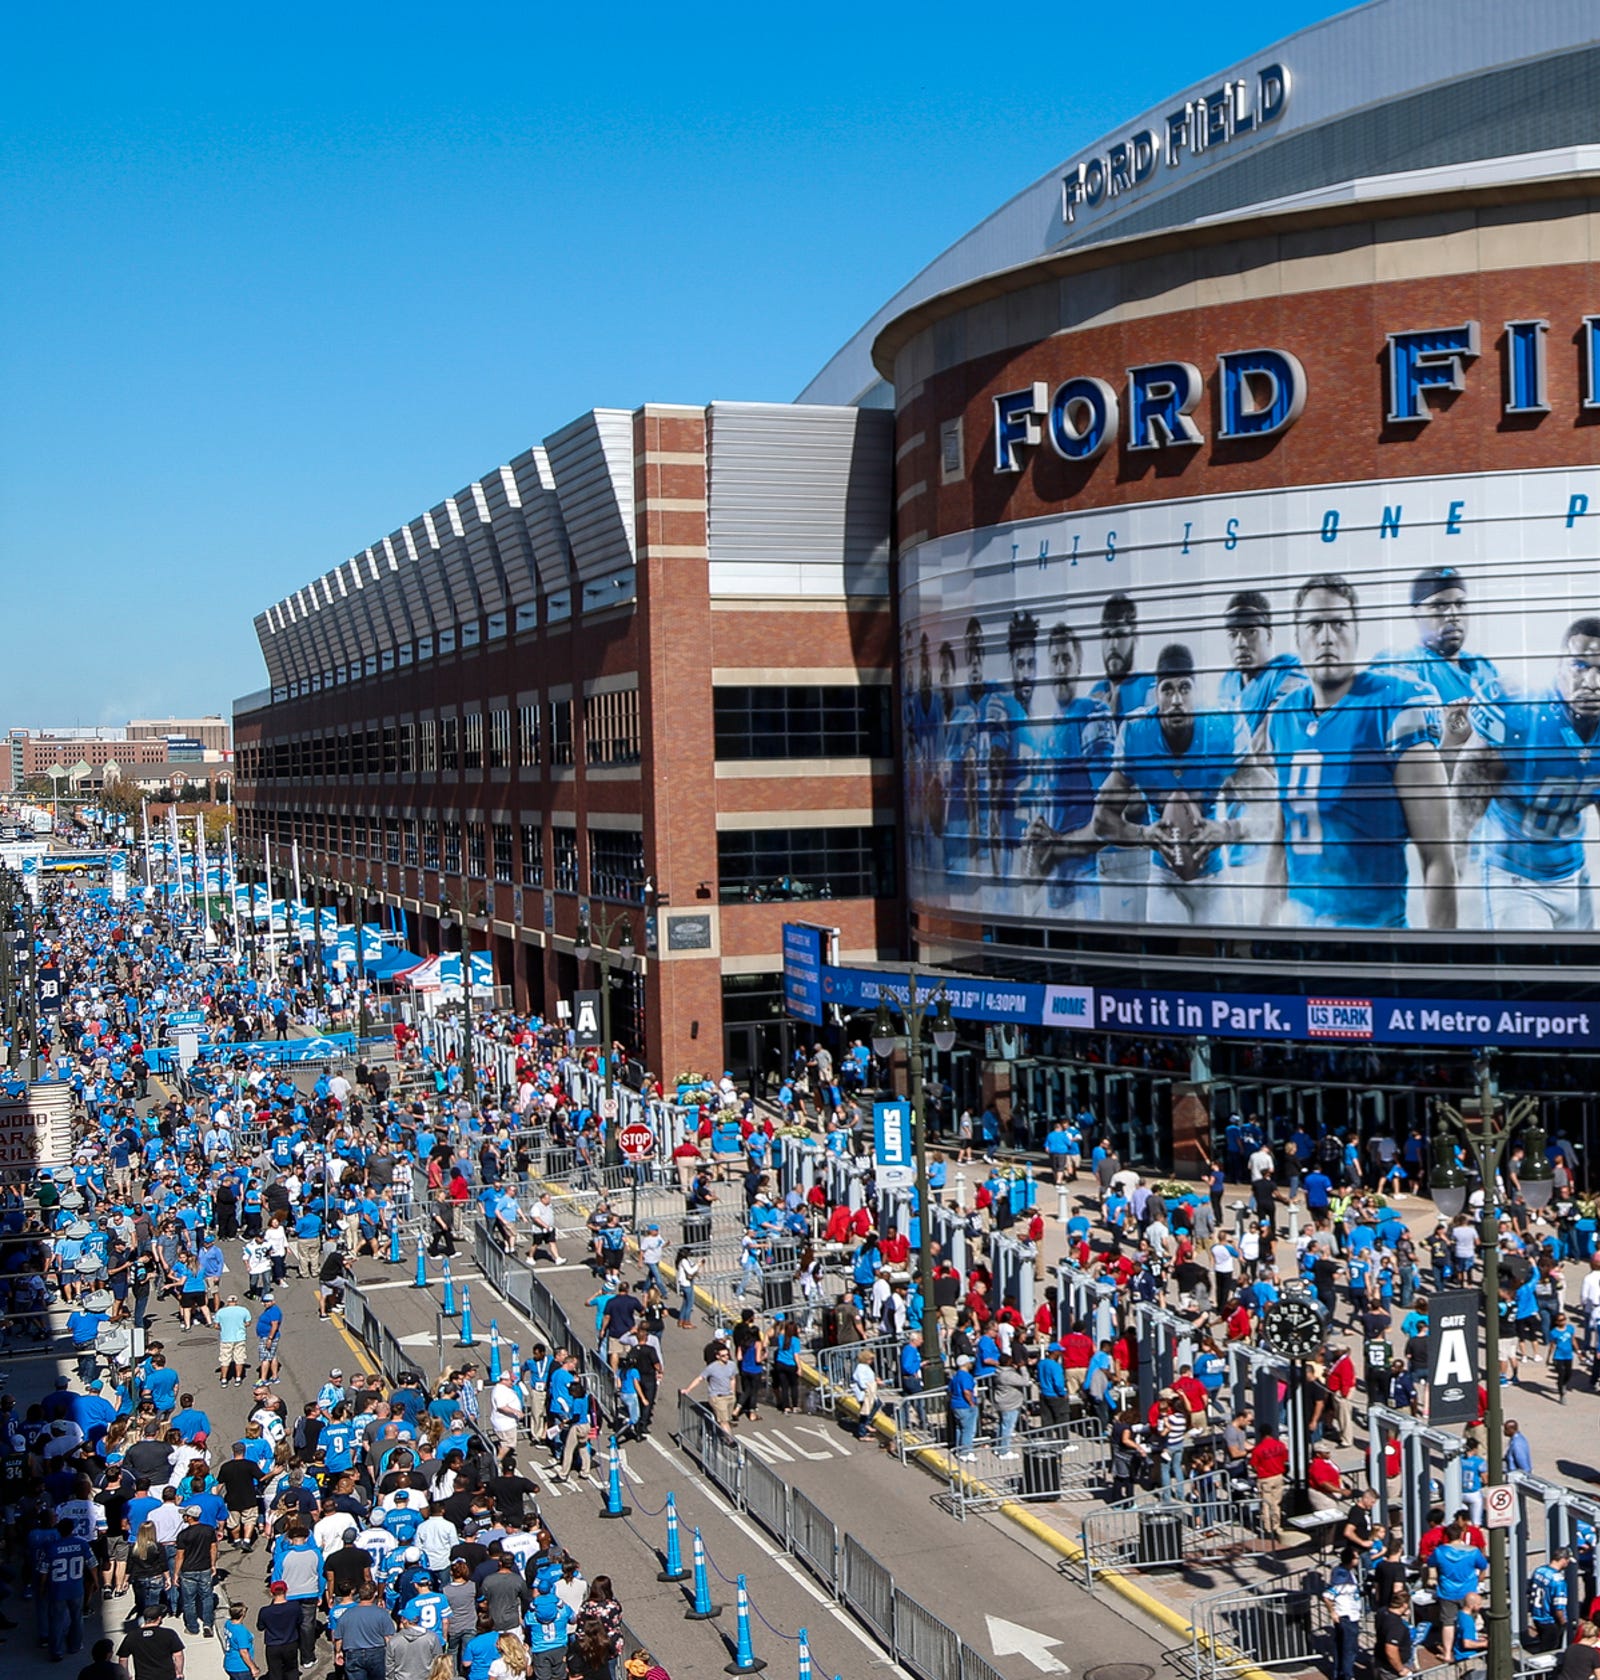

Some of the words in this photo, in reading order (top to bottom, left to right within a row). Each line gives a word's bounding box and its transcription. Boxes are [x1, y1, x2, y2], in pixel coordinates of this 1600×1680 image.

[1061, 128, 1160, 223] FORD
[1164, 63, 1293, 167] FIELD
[992, 347, 1308, 474] FORD
[1010, 530, 1118, 574] THIS
[1181, 518, 1239, 554] IS
[1320, 500, 1465, 543] ONE
[1286, 749, 1323, 855] 9
[986, 992, 1026, 1013] 4:30PM
[1051, 995, 1087, 1016] HOME
[1100, 995, 1144, 1026] Put
[1149, 997, 1169, 1027] it
[1177, 998, 1203, 1028] in
[1211, 1000, 1292, 1032] Park.
[577, 1008, 597, 1031] A
[1333, 1007, 1369, 1026] PARK
[1389, 1008, 1415, 1031] At
[1420, 1009, 1491, 1034] Metro
[1495, 1011, 1591, 1038] Airport
[621, 1133, 650, 1147] STOP
[884, 1108, 902, 1162] LIONS
[1440, 1315, 1466, 1329] GATE
[1368, 1350, 1385, 1366] 12
[1433, 1329, 1473, 1386] A
[333, 1436, 343, 1454] 9
[734, 1423, 853, 1464] NLY
[6, 1467, 22, 1479] 34
[51, 1556, 84, 1582] 20
[420, 1604, 436, 1629] 9
